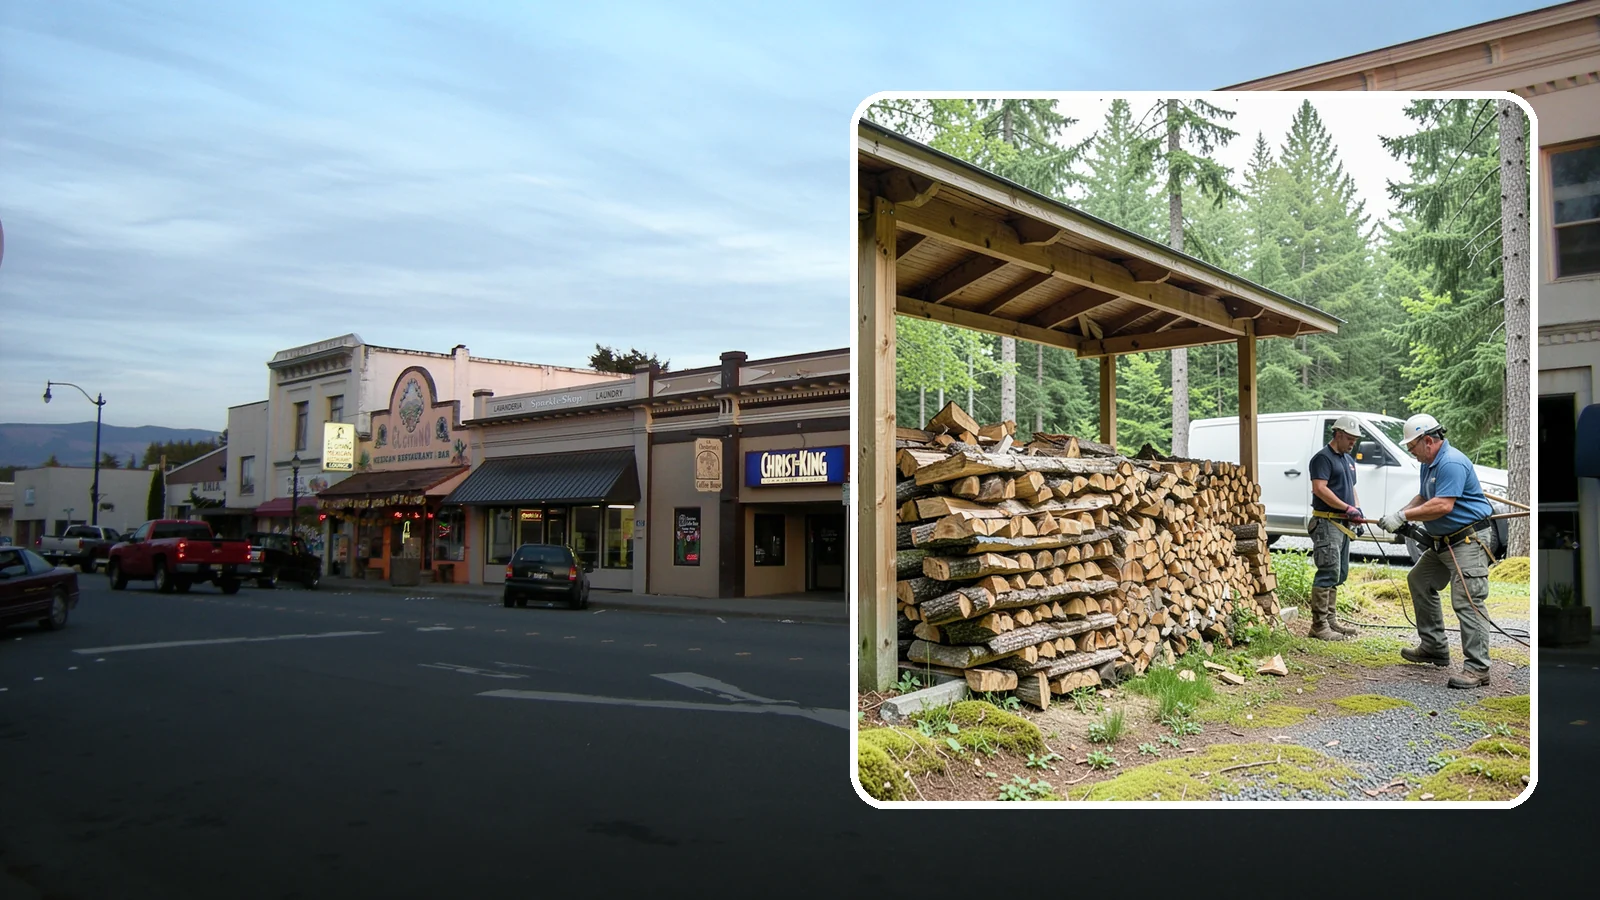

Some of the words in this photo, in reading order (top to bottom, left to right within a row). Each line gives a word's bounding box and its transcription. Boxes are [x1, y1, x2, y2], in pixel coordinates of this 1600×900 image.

[561, 394, 583, 405] Shop
[595, 389, 623, 400] LAUNDRY
[493, 402, 522, 413] LAVANDERIA
[373, 455, 396, 465] MEXICAN
[397, 451, 433, 463] RESTAURANT
[437, 450, 450, 459] BAR
[761, 452, 797, 478] CHRIST
[799, 450, 828, 476] KING
[696, 481, 709, 489] Coffee
